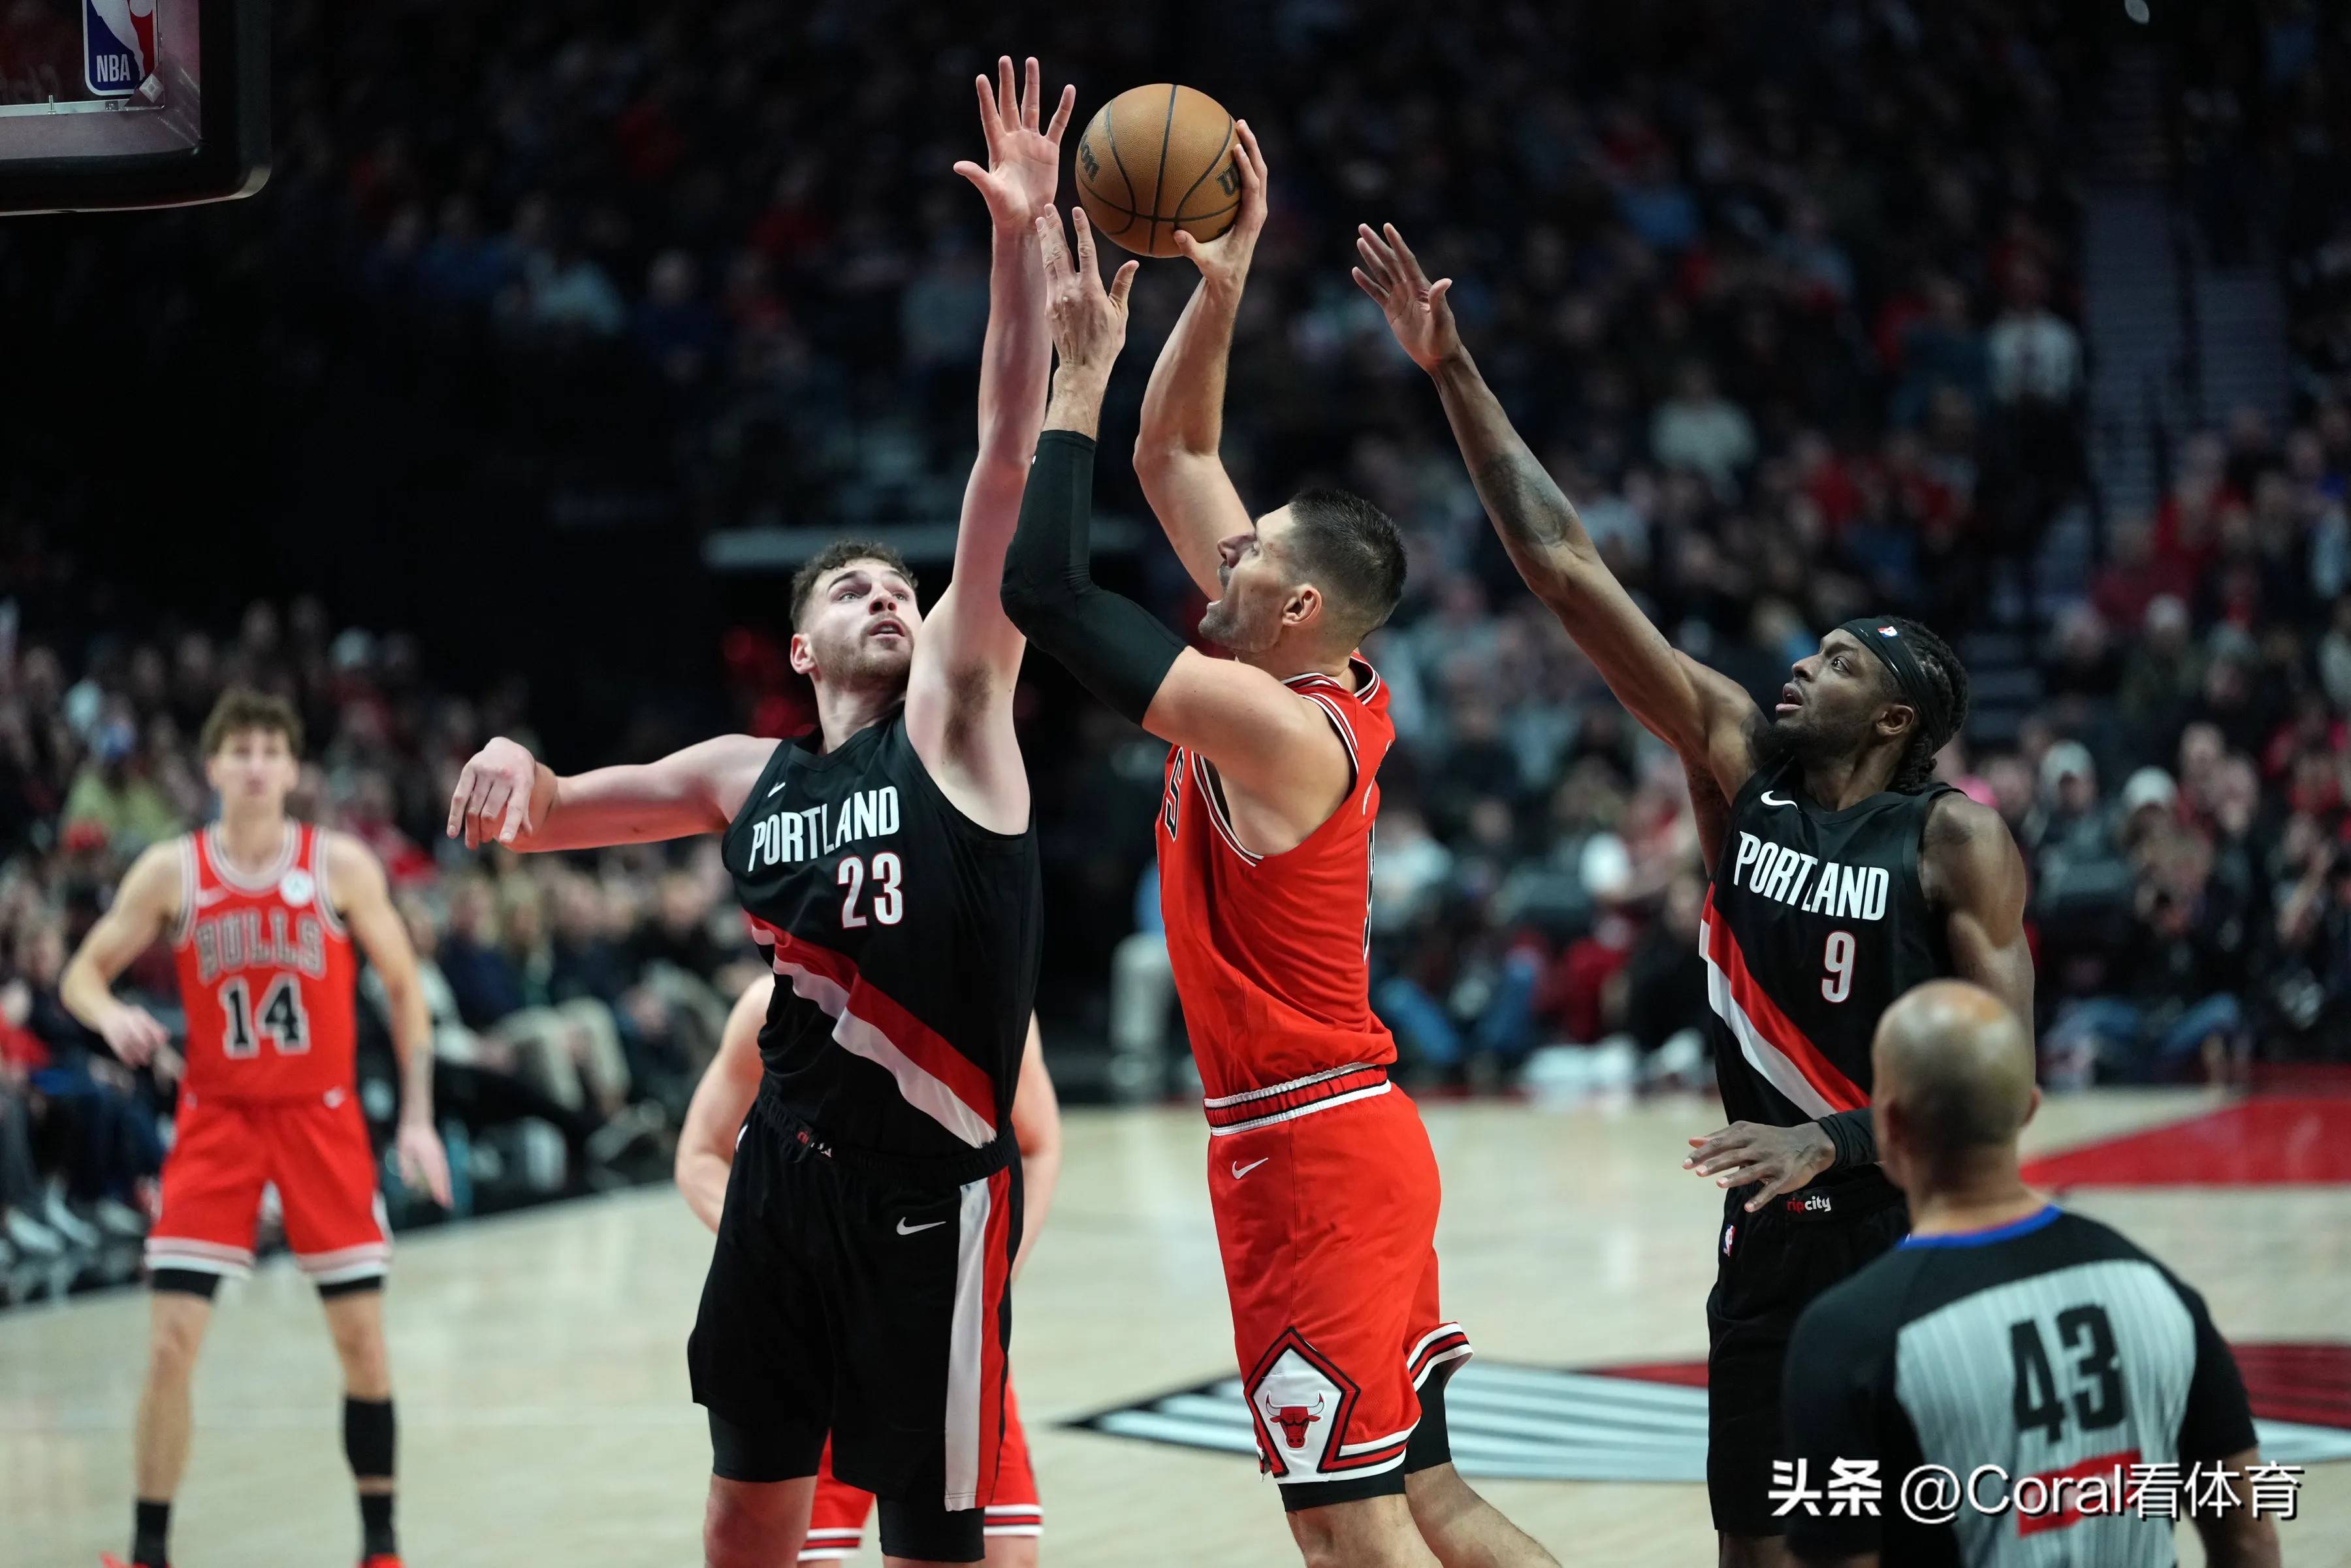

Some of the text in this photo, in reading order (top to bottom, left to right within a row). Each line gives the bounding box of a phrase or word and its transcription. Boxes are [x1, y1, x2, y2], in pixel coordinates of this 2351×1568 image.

[96, 54, 131, 82] NBA
[748, 786, 900, 872] PORTLAND
[837, 851, 904, 929] 23
[195, 908, 327, 985] BULLS
[1820, 929, 1857, 1004] 9
[218, 973, 311, 1059] 14
[2010, 1302, 2126, 1446] 43
